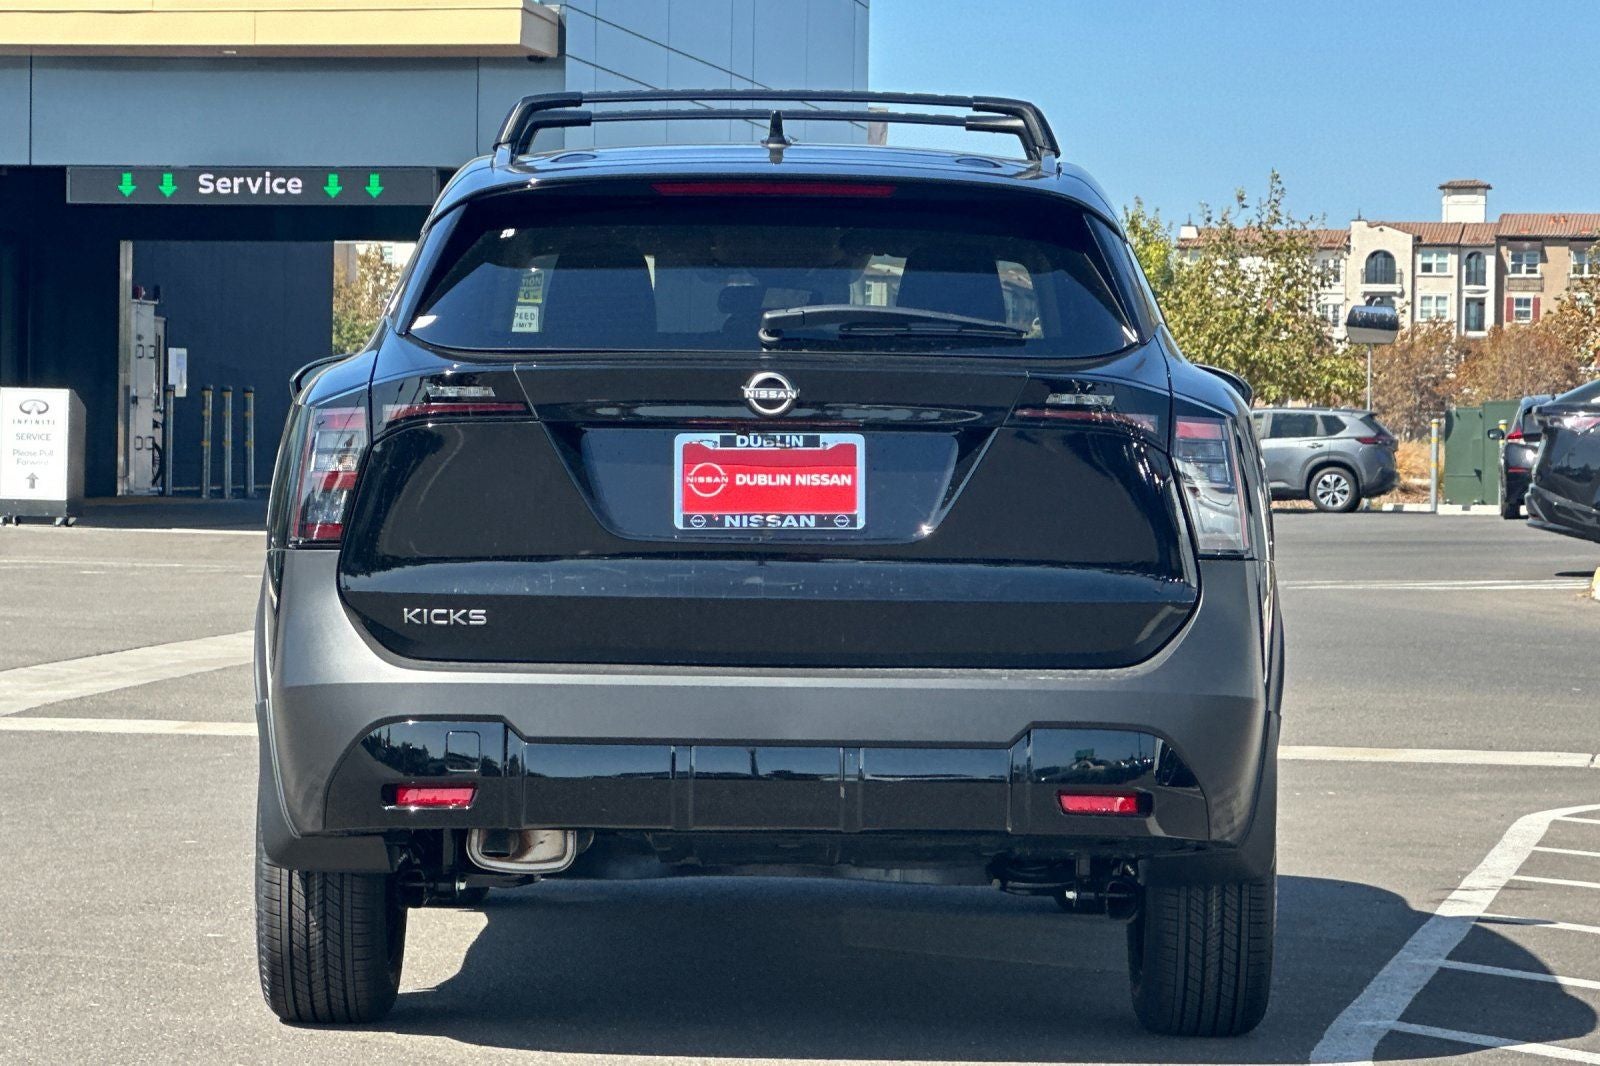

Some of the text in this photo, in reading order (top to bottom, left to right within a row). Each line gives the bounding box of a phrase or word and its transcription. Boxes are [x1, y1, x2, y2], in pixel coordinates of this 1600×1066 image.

[198, 171, 303, 194] Service
[514, 312, 535, 321] PEED
[744, 389, 797, 399] NISSAN
[15, 432, 52, 441] SERVICE
[736, 435, 804, 448] DUBLIN
[686, 475, 729, 484] NISSAN
[735, 473, 852, 486] DUBLIN NISSAN
[724, 515, 816, 528] NISSAN
[403, 607, 488, 626] KICKS
